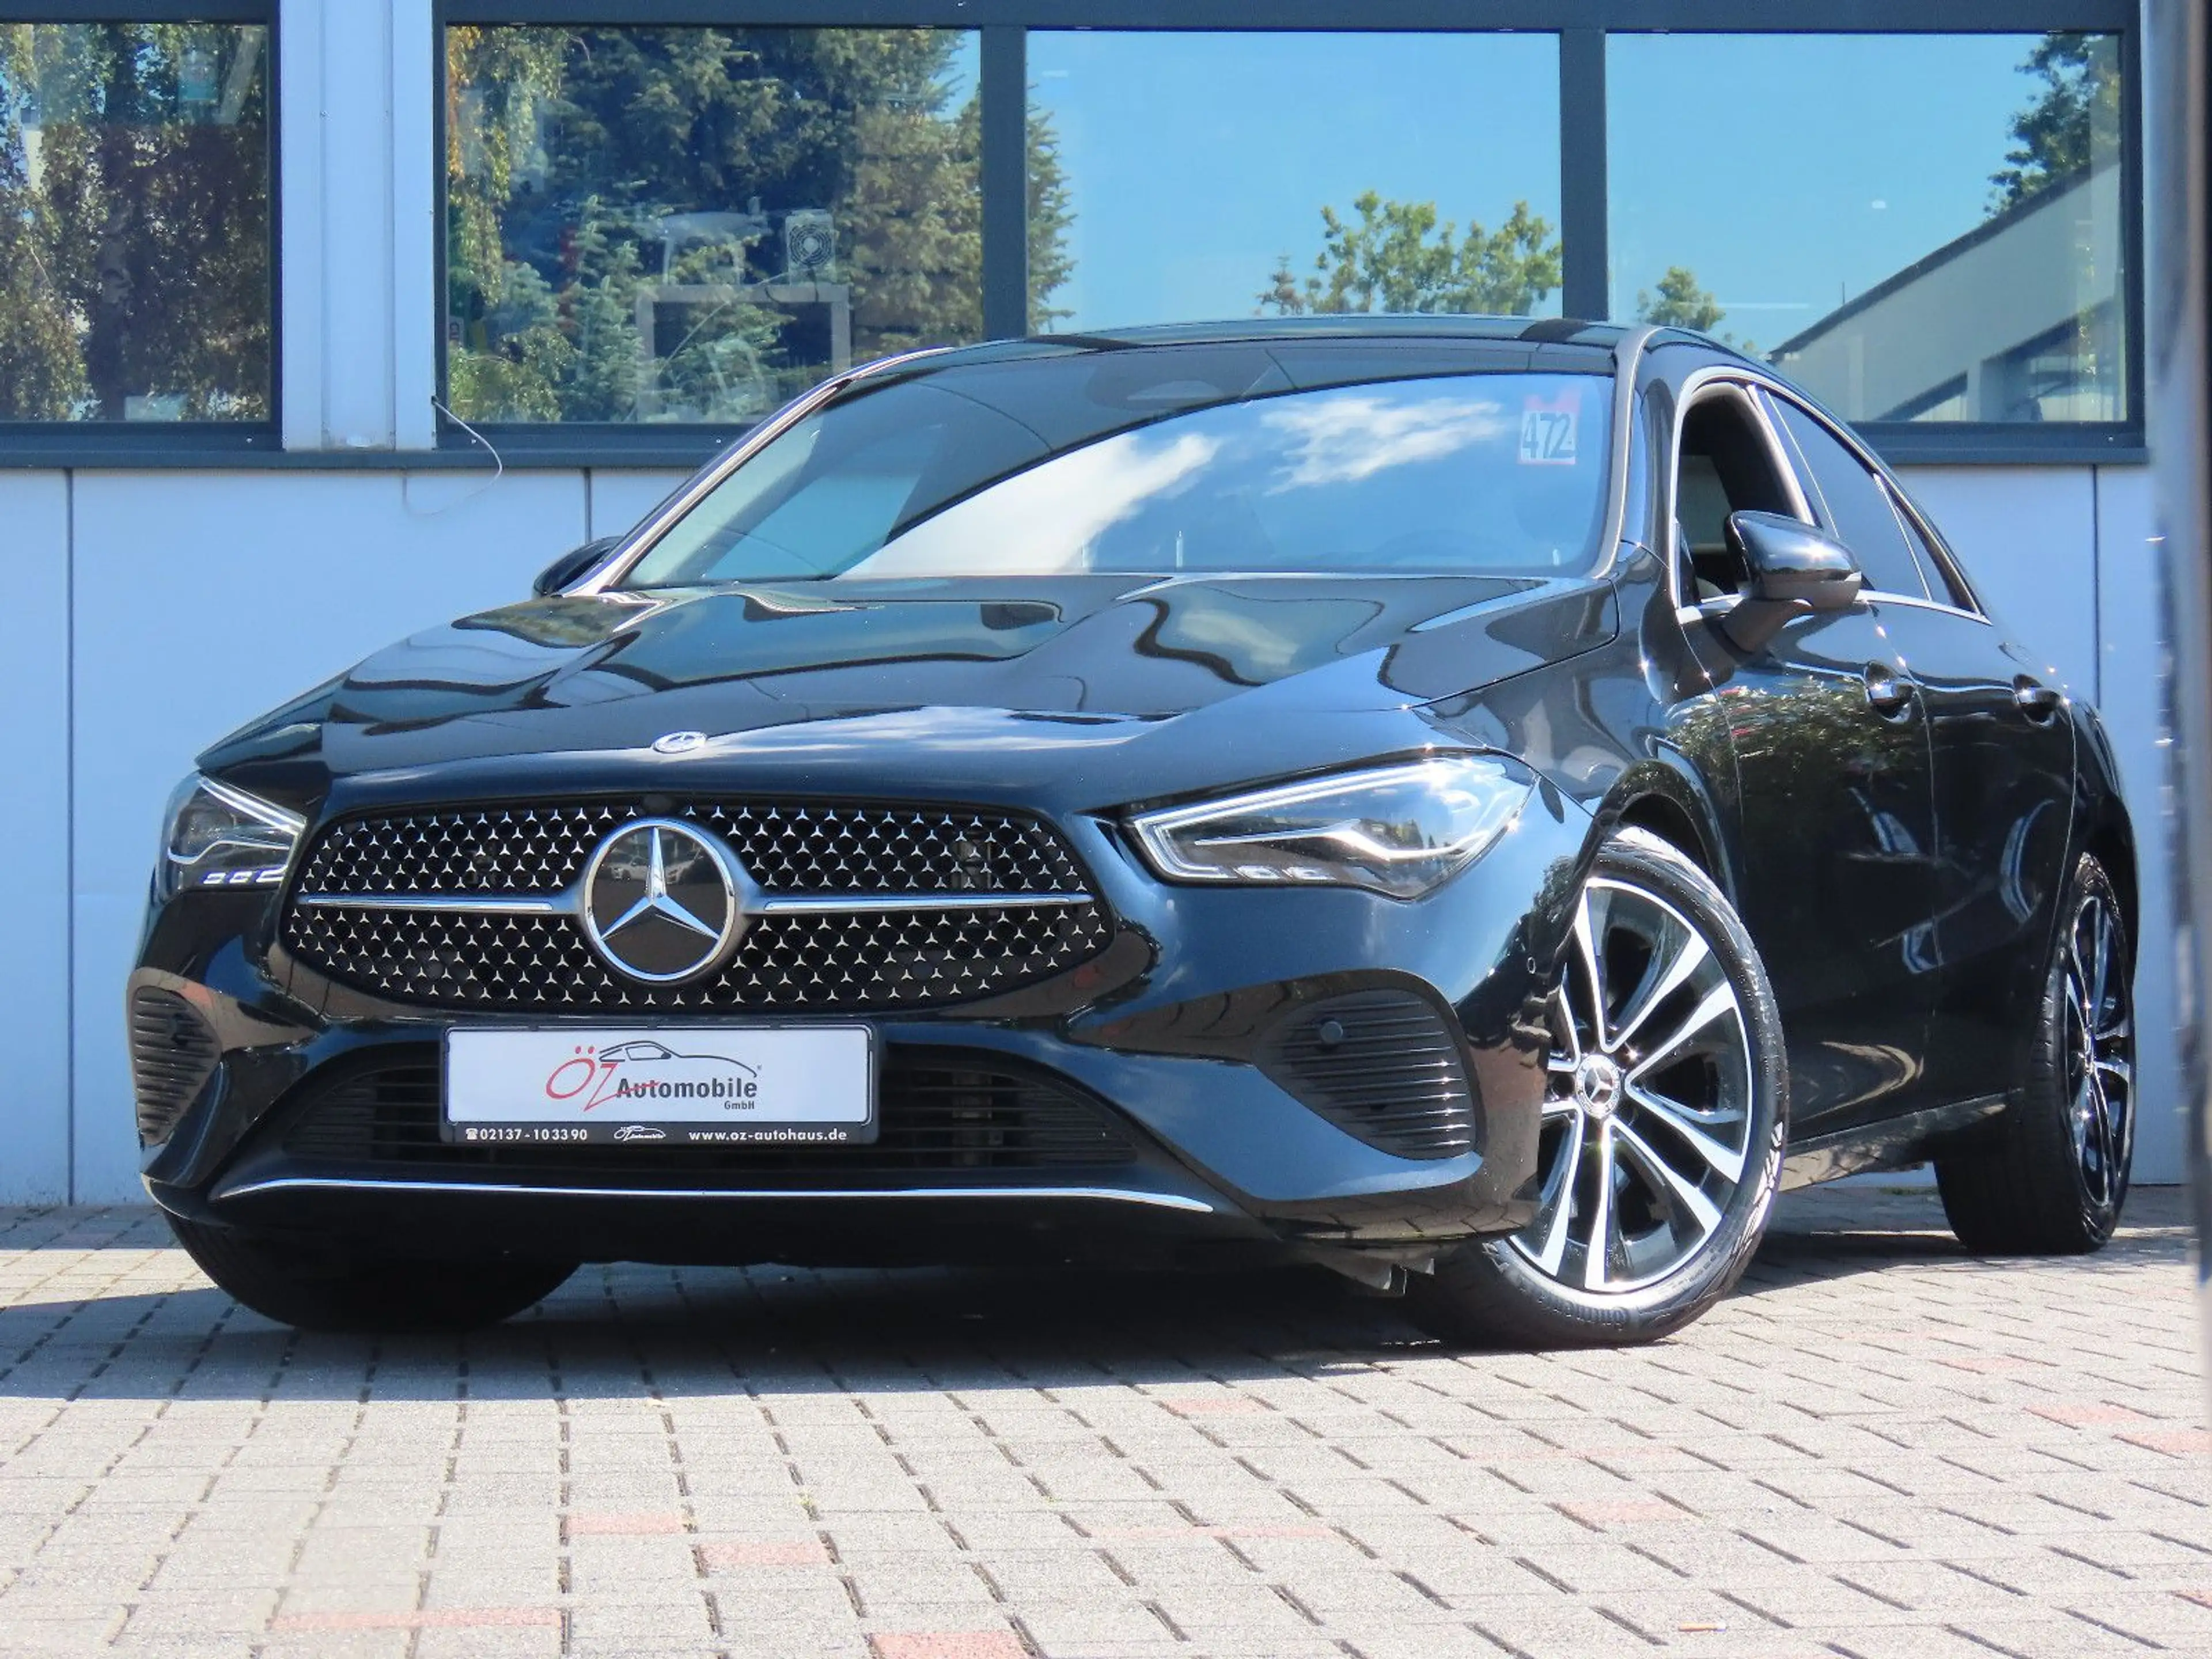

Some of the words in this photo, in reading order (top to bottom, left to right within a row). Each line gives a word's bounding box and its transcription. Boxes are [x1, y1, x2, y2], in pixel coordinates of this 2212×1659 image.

[1522, 412, 1579, 459] 472
[616, 1077, 757, 1098] Automobile
[724, 1100, 755, 1110] GmbH
[688, 1127, 847, 1141] www.oz-autohaus.de
